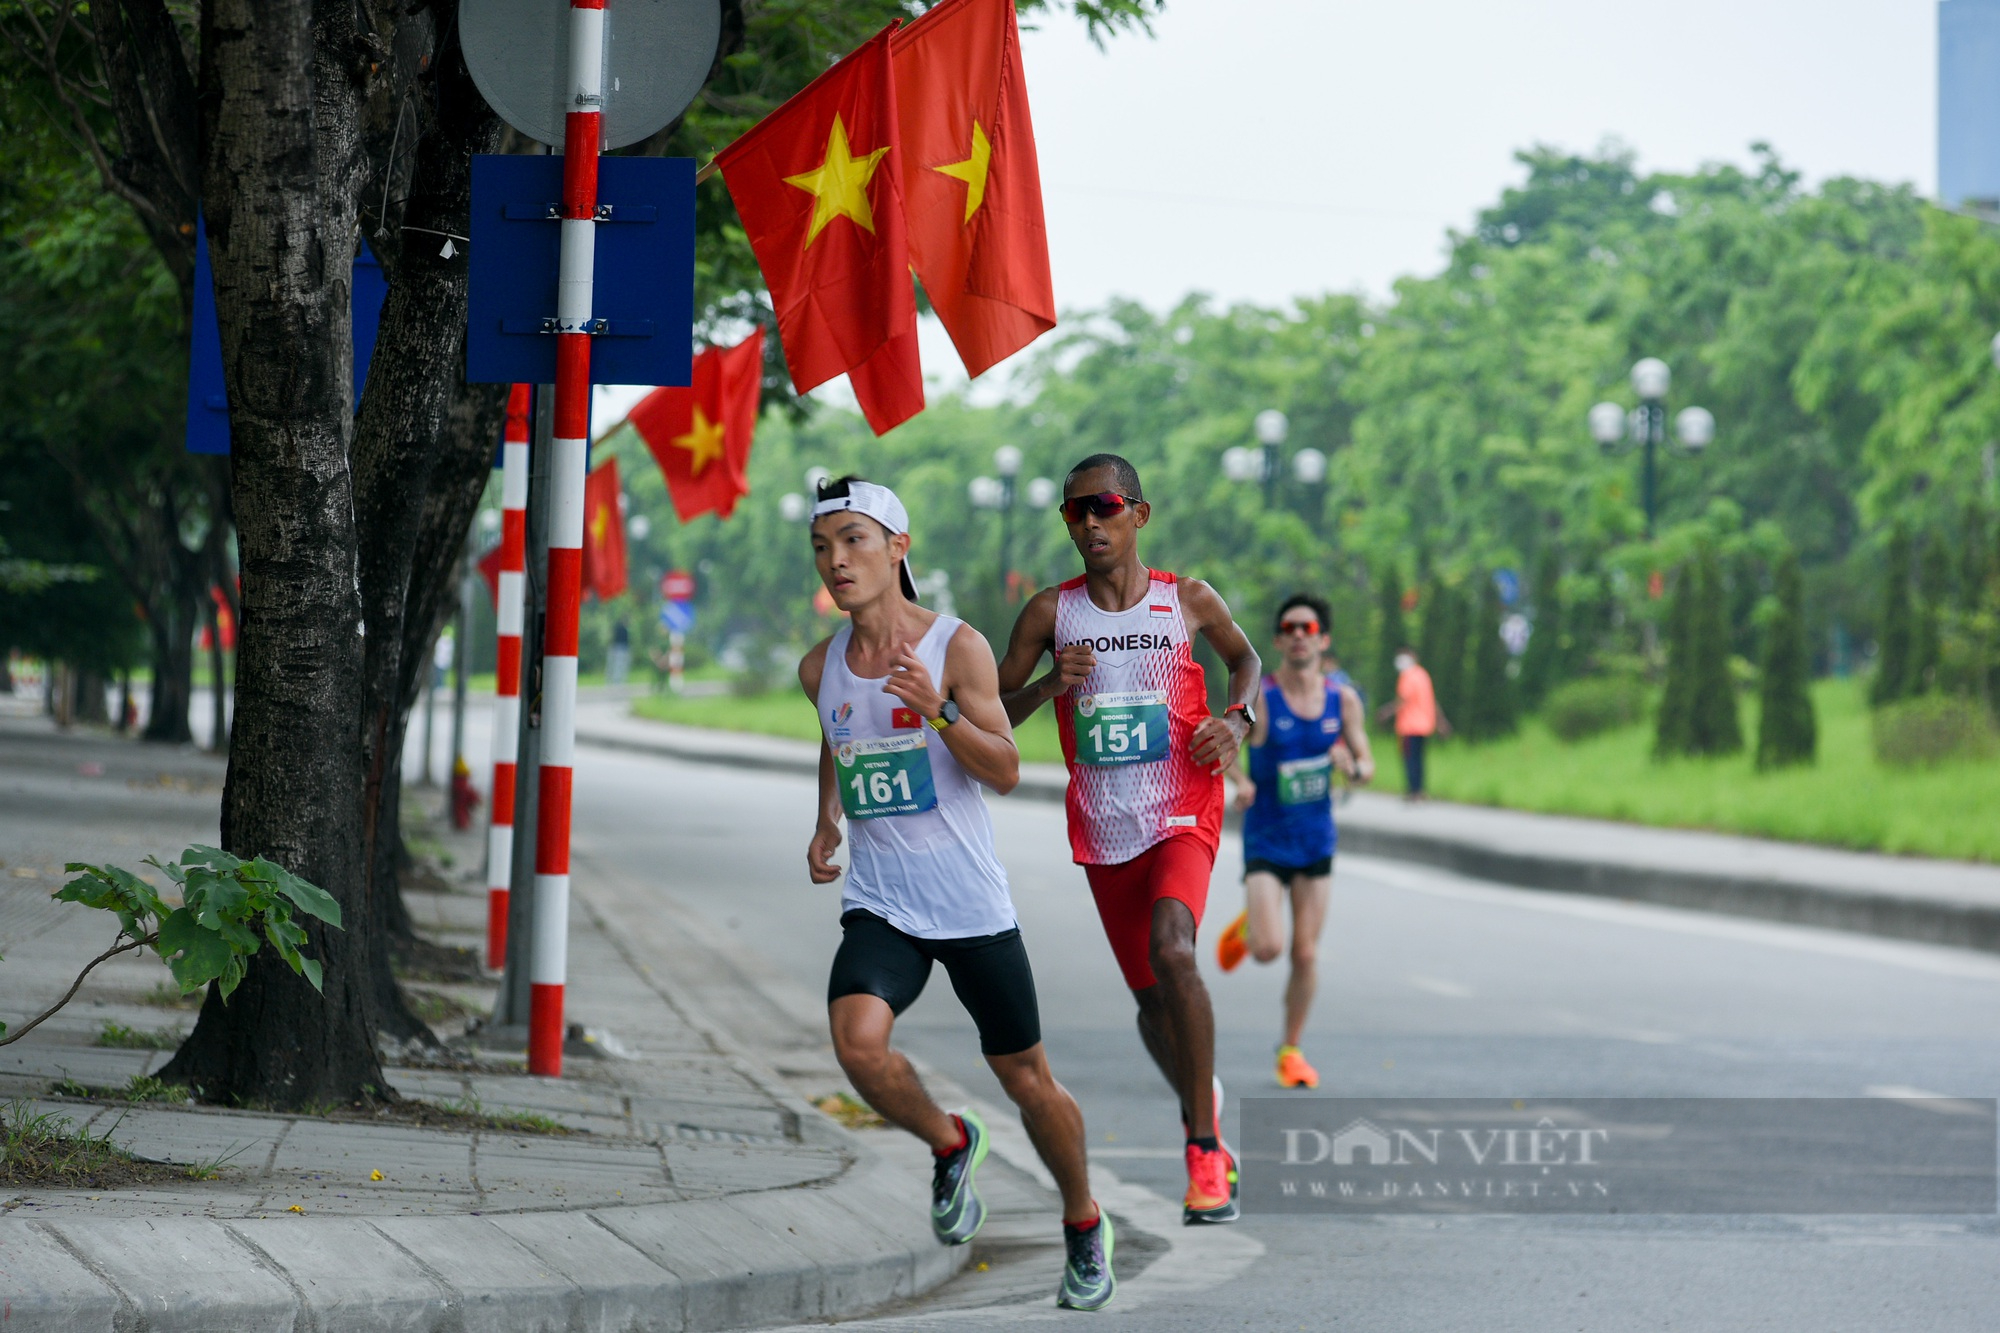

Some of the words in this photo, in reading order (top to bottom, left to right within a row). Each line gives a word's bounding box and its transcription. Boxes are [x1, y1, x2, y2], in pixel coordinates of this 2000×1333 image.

[1064, 634, 1173, 653] DONESIA
[1101, 713, 1134, 721] INDONESIA
[1088, 722, 1148, 753] 151
[863, 761, 891, 769] VIETNAM
[850, 769, 912, 805] 161
[854, 807, 873, 816] HOANG
[873, 805, 897, 814] NGUYEN
[897, 803, 919, 812] THANH
